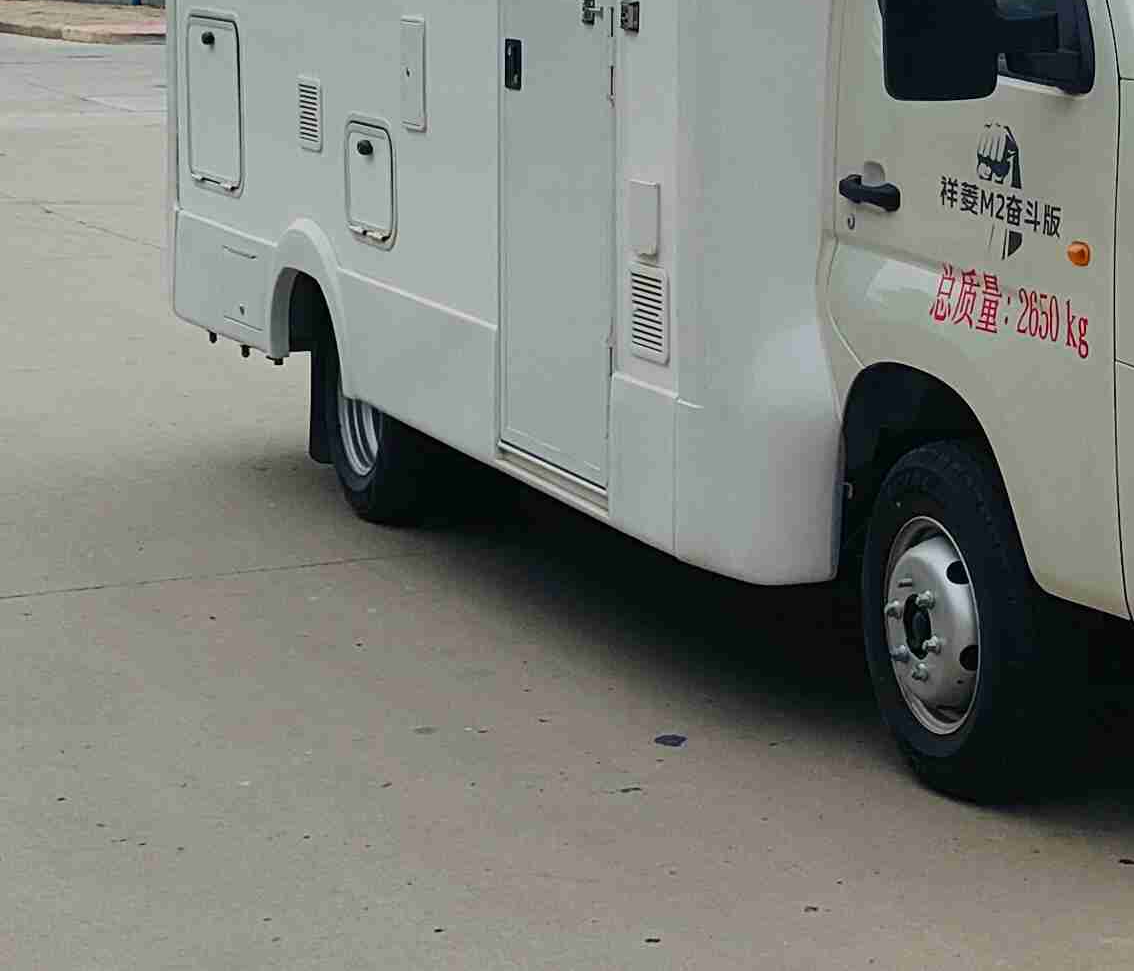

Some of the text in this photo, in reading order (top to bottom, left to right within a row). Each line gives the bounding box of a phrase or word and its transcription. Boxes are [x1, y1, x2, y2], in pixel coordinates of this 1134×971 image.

[939, 175, 1062, 238] 祥菱M2奋斗版
